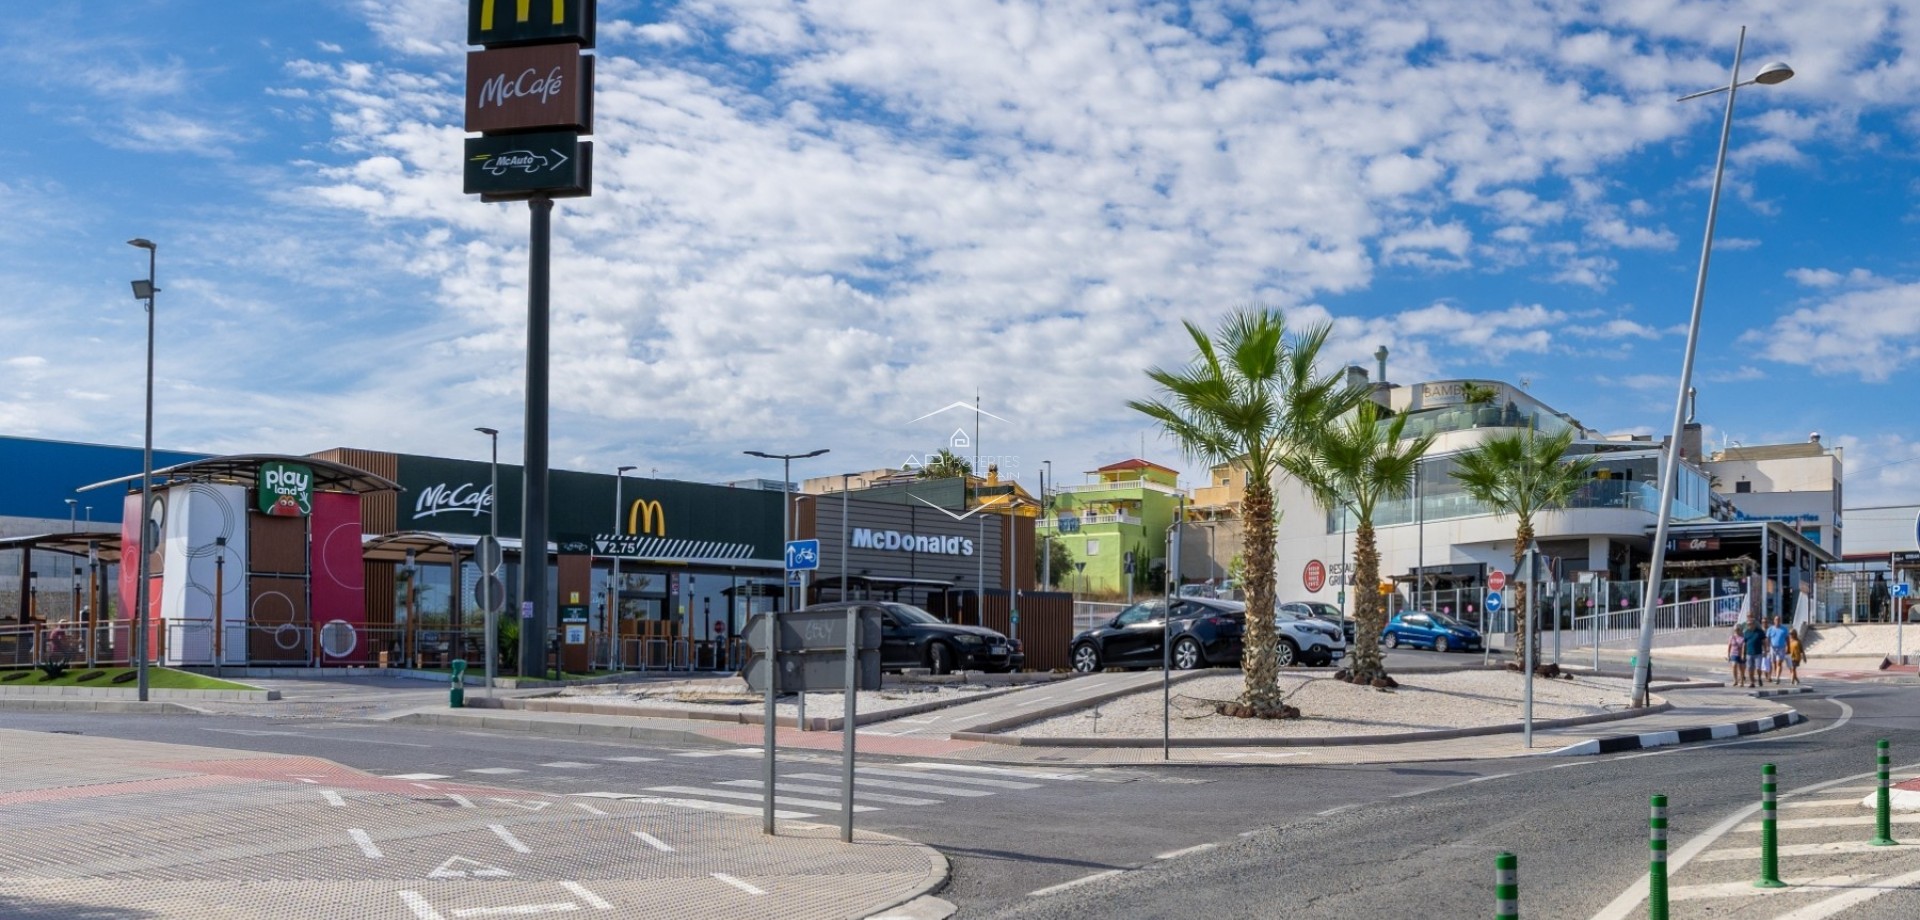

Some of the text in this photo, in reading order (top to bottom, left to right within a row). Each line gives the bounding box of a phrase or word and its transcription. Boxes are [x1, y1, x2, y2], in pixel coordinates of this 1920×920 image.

[478, 66, 563, 108] McCafé
[496, 153, 534, 167] McAuto
[265, 465, 308, 492] play
[274, 484, 298, 496] land
[608, 542, 636, 554] 2.75
[852, 527, 974, 556] McDonald's
[1892, 585, 1901, 596] P
